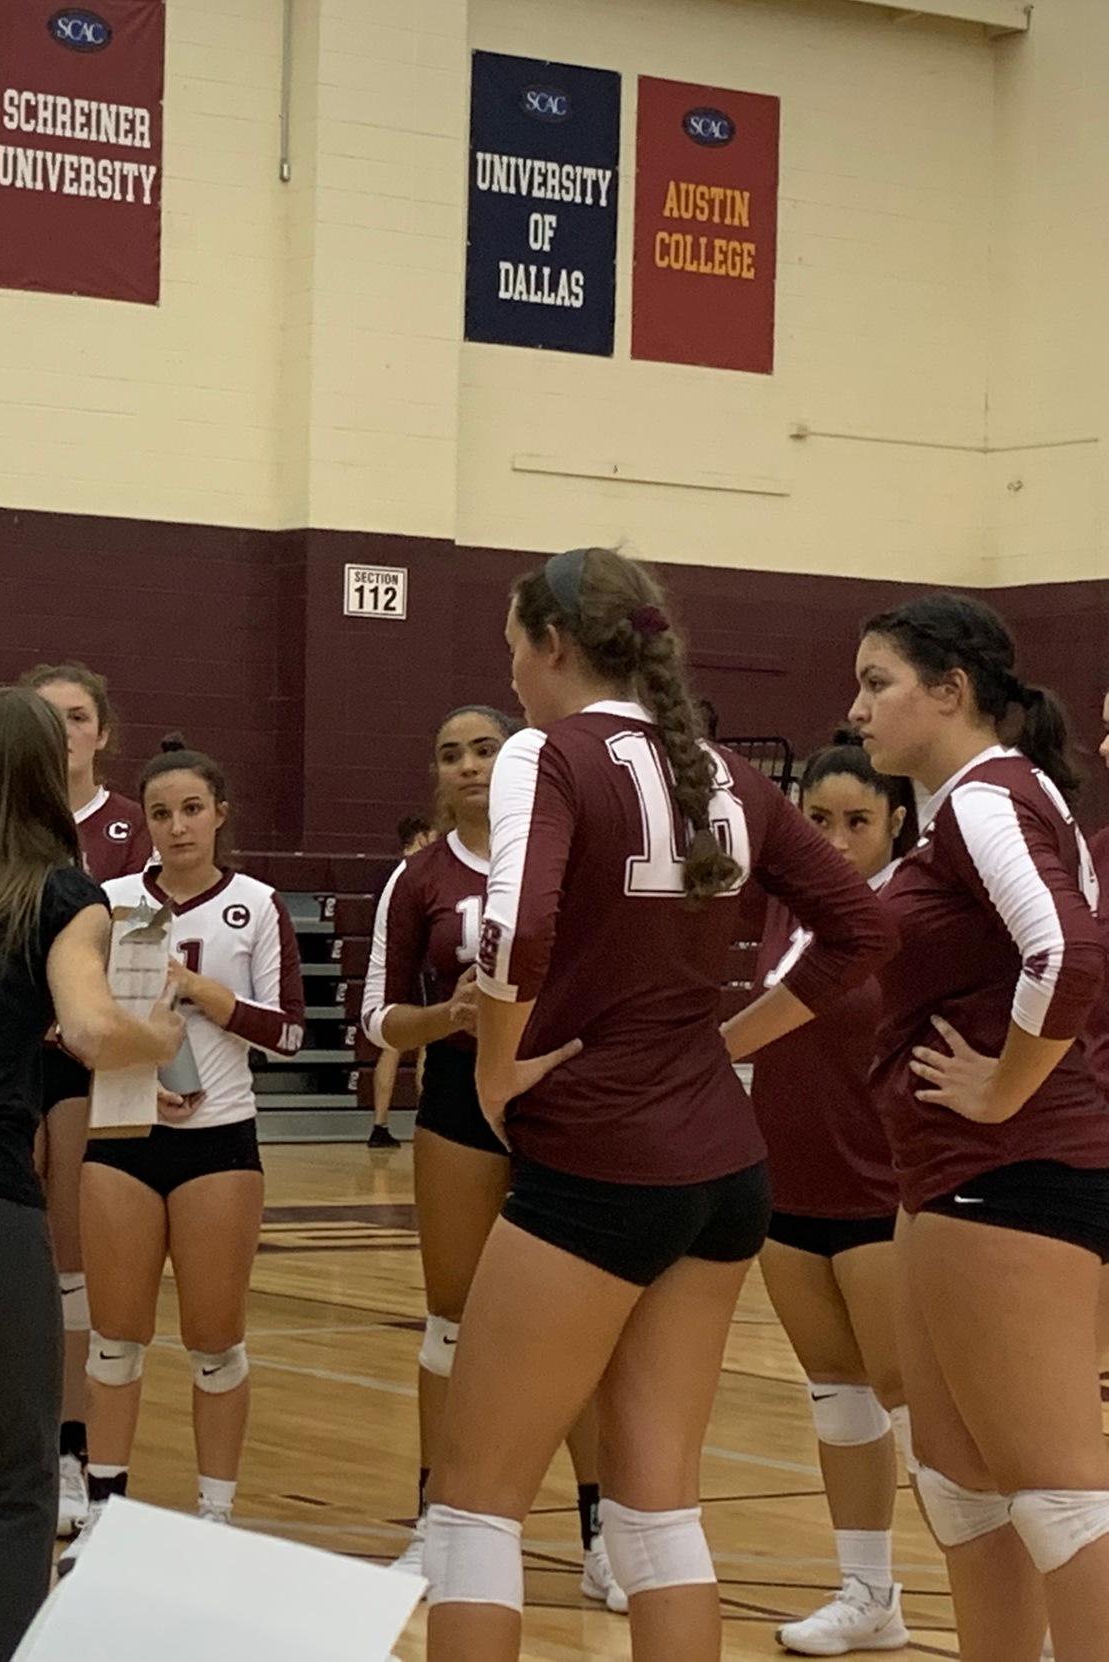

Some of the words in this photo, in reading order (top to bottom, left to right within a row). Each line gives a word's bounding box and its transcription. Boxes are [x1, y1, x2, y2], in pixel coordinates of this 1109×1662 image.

[56, 17, 104, 45] SCAC
[525, 91, 567, 116] SCAC
[3, 88, 152, 148] SCHREINER
[689, 116, 728, 140] SCAC
[476, 152, 612, 207] UNIVERSITY
[663, 180, 751, 227] AUSTIN
[528, 212, 557, 252] OF
[655, 231, 756, 280] COLLEGE
[498, 261, 584, 308] DALLAS
[354, 571, 399, 585] SECTION
[354, 584, 397, 611] 112
[108, 821, 129, 839] C
[226, 907, 247, 926] C
